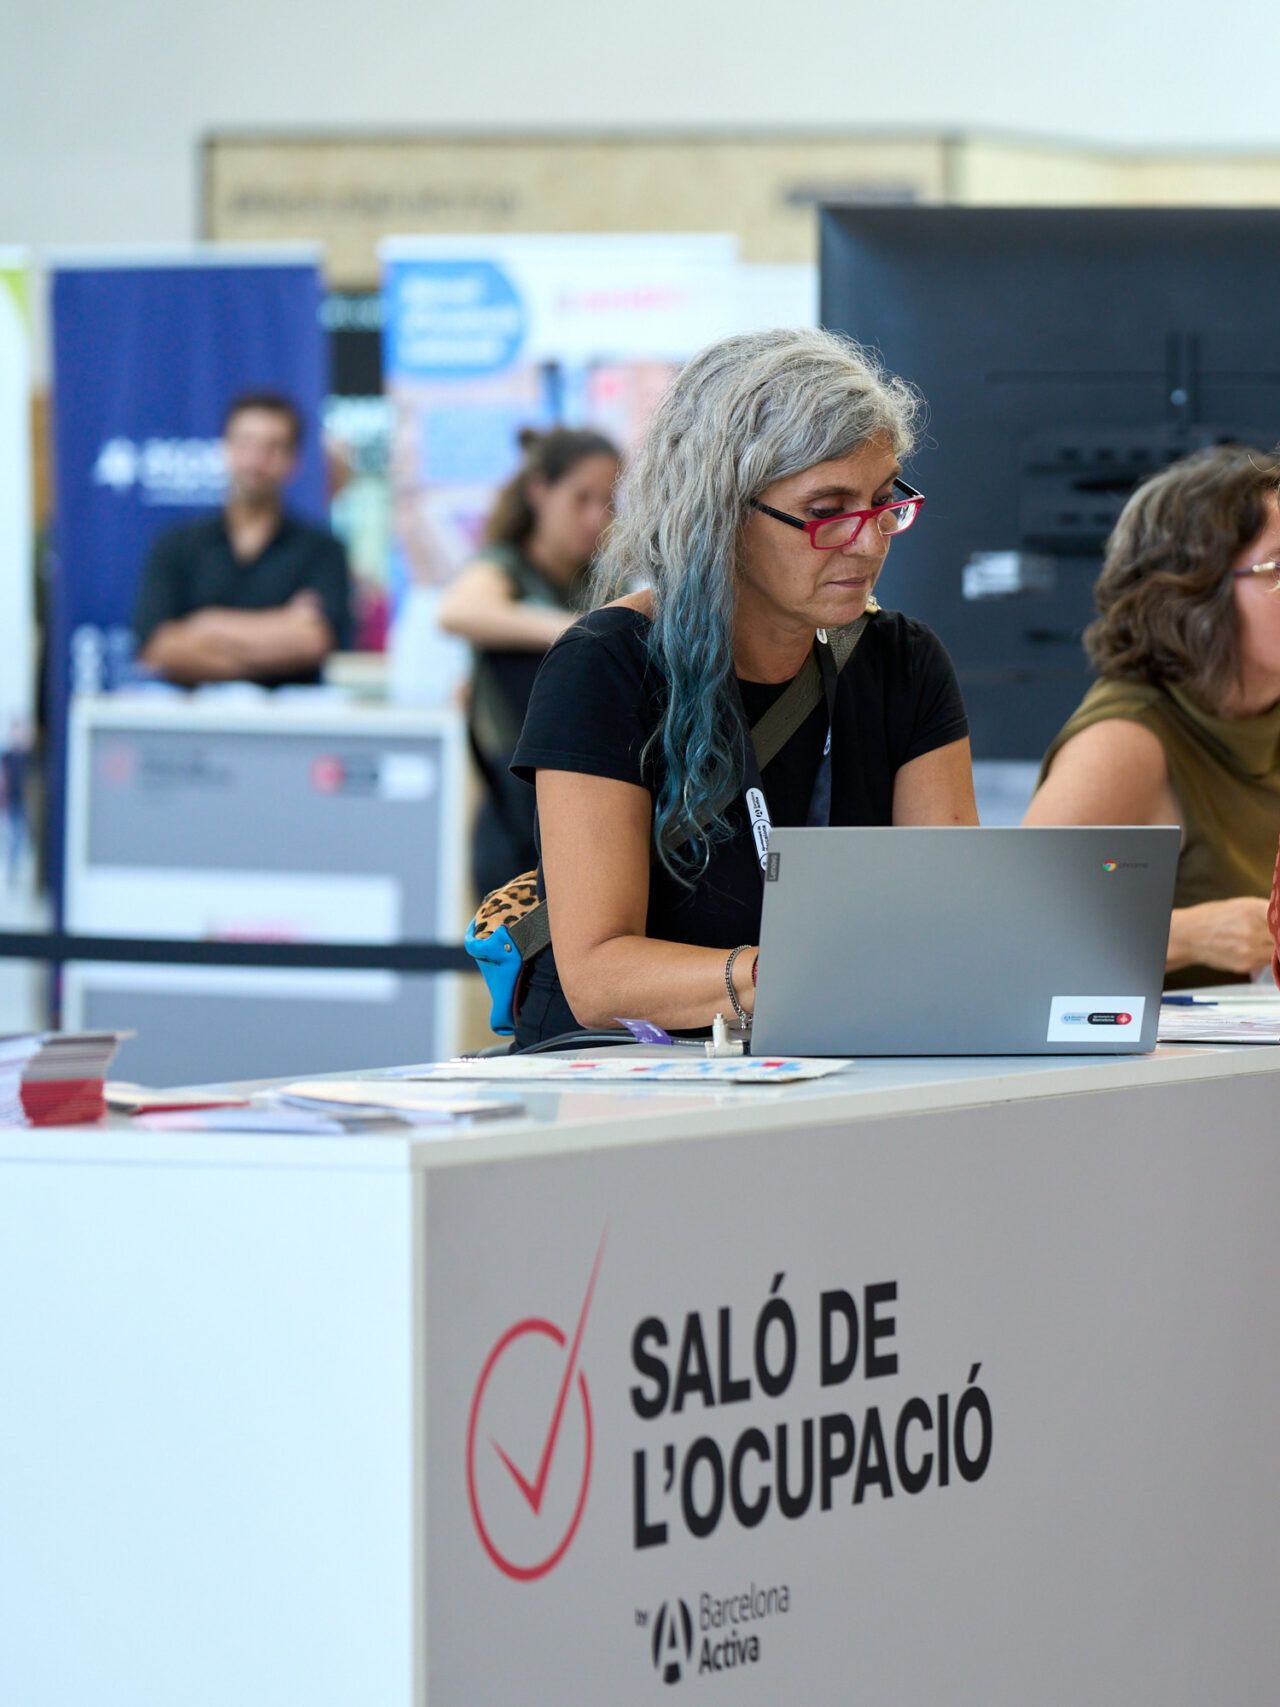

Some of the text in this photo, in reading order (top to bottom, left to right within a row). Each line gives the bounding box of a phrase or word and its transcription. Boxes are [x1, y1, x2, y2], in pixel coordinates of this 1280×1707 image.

[630, 1272, 900, 1420] SALÓ DE
[633, 1362, 994, 1550] L'OCUPACIÓ
[698, 1629, 760, 1675] Activa
[699, 1582, 791, 1632] Barcelona
